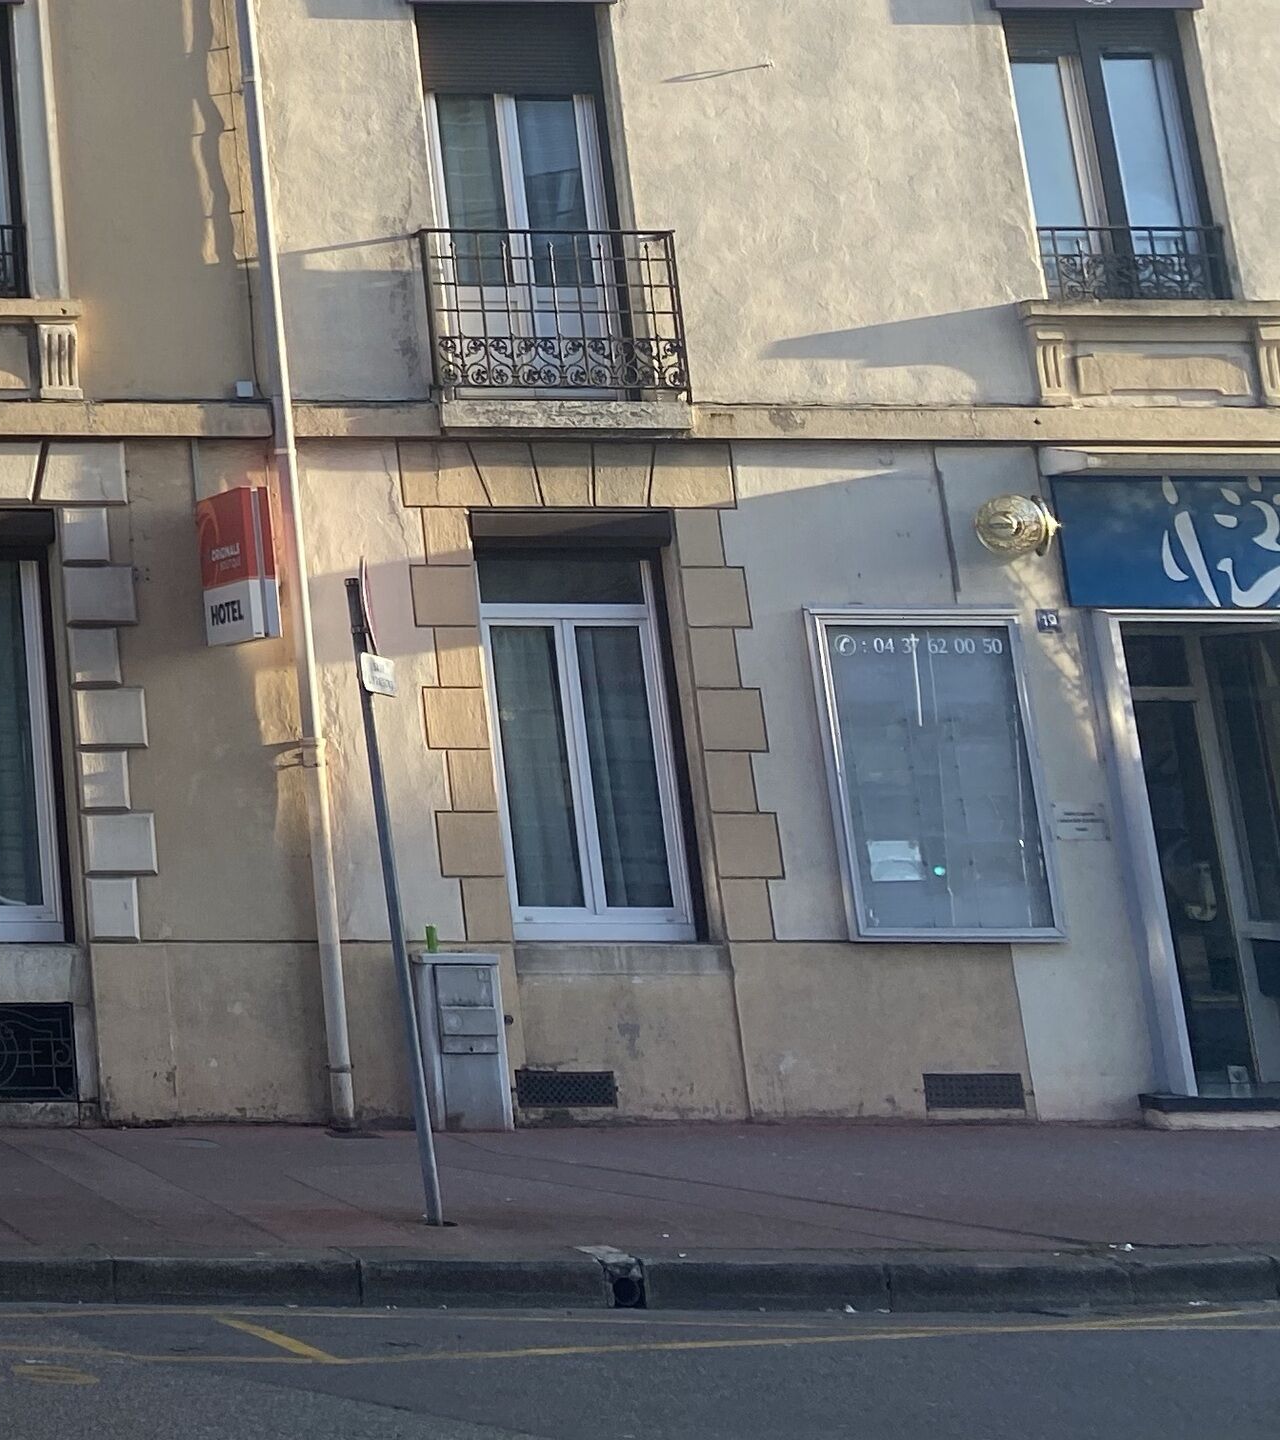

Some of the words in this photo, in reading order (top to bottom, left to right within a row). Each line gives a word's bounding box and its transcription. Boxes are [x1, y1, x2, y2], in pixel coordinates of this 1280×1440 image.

[210, 599, 244, 627] HOTEL
[1041, 613, 1058, 627] 19
[873, 637, 895, 654] 04
[928, 638, 948, 654] 62
[954, 638, 976, 654] 00
[983, 638, 1003, 654] 50
